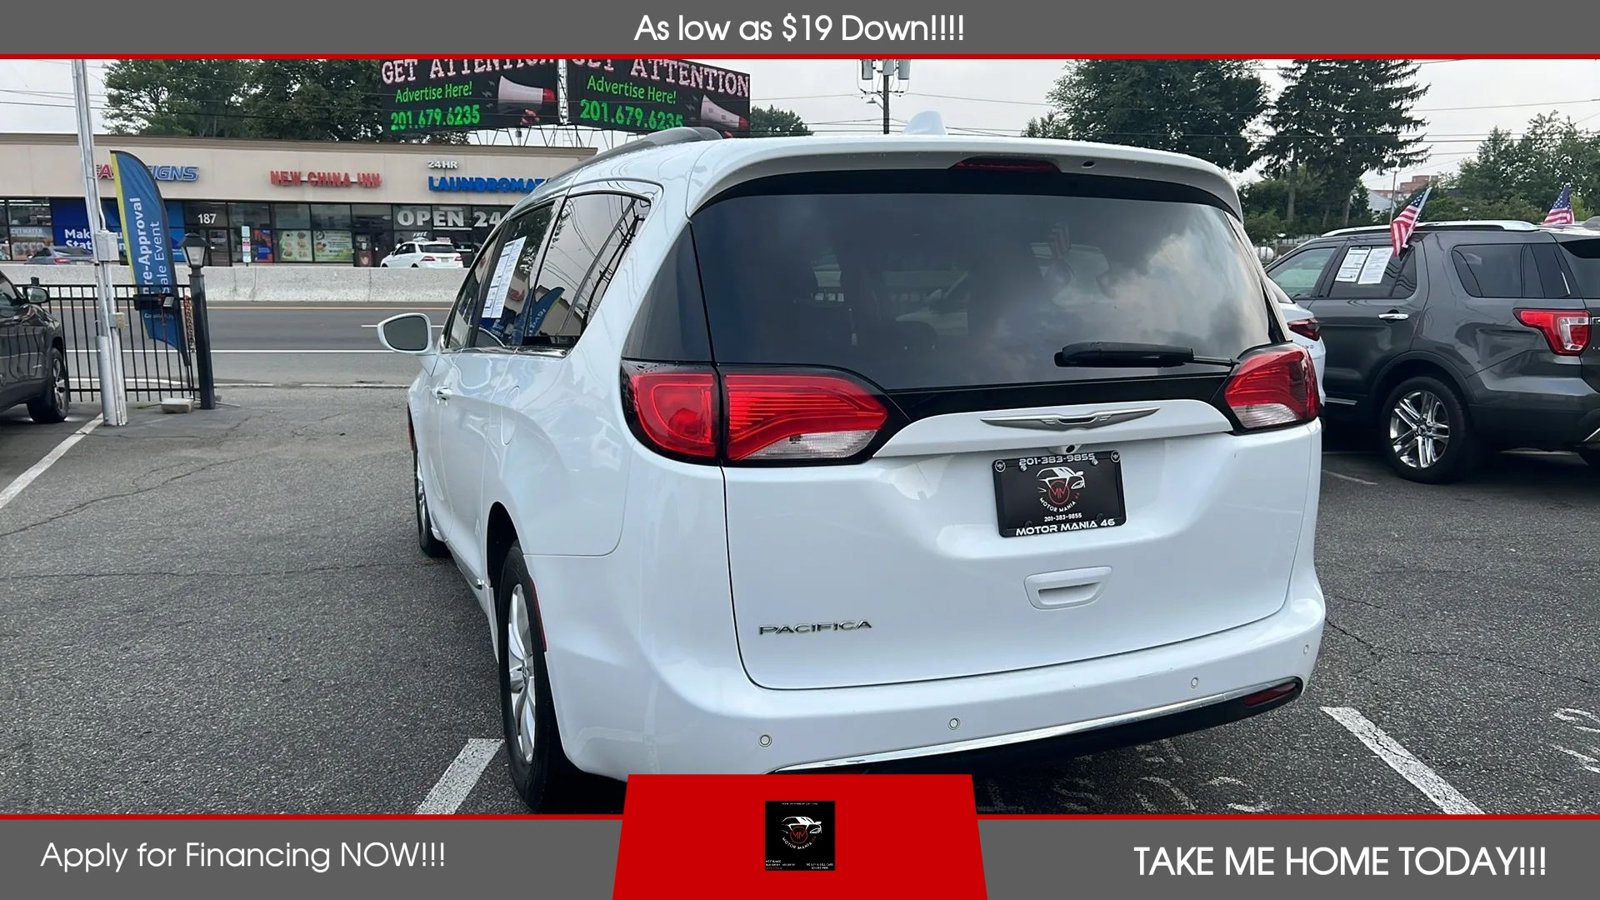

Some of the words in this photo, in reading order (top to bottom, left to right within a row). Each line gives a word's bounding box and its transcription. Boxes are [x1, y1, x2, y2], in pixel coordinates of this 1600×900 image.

[382, 59, 417, 84] GET
[630, 58, 750, 98] ATTENTION
[395, 87, 442, 104] Advertise
[445, 81, 473, 99] Here!
[586, 75, 645, 99] Advertise
[648, 86, 677, 105] Here!
[391, 104, 481, 131] 201.679.6235
[580, 98, 685, 130] 201.679.6235
[270, 170, 302, 188] NEW
[307, 171, 352, 188] CHINA
[357, 172, 382, 189] INN
[197, 213, 217, 225] 187
[397, 210, 465, 227] OPEN
[64, 228, 92, 240] Mak
[150, 221, 164, 261] Event
[1019, 453, 1095, 465] 201-383-9855
[1040, 497, 1058, 513] MOTOR
[1059, 500, 1076, 513] MANIA
[1015, 524, 1058, 537] MOTOR
[1060, 520, 1098, 532] MANIA
[1100, 518, 1116, 527] 46
[759, 619, 872, 635] PACIFICA
